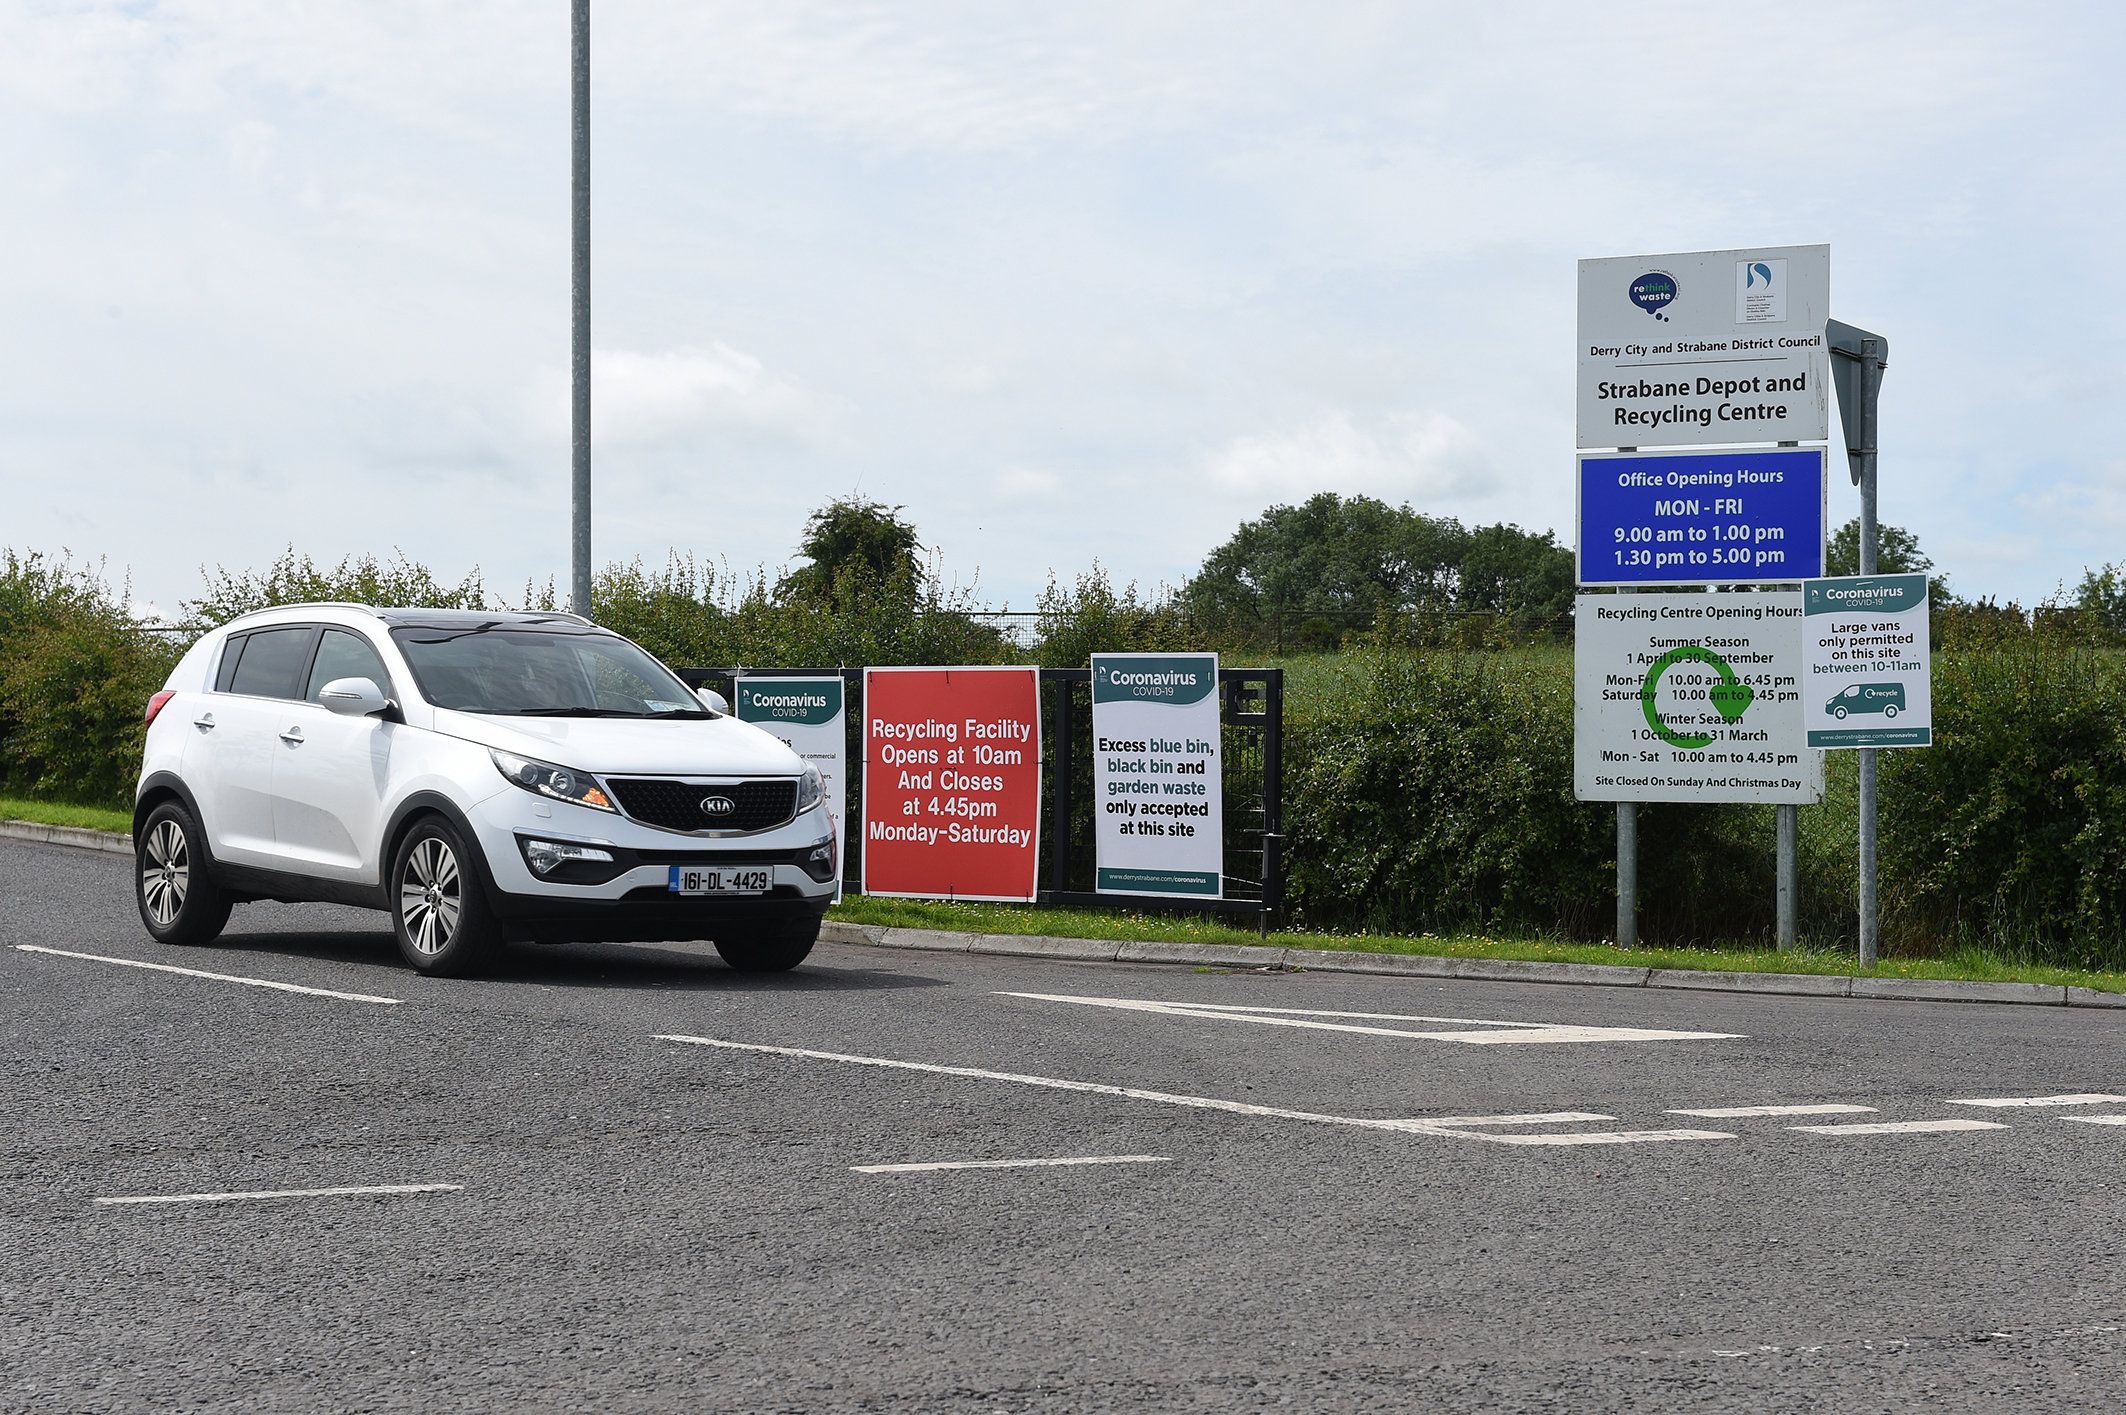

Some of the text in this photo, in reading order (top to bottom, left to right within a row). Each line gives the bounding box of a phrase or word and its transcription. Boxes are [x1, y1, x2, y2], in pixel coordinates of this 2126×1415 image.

[1634, 282, 1670, 292] rethink
[1640, 292, 1670, 301] waste
[1590, 336, 1820, 358] Derry City and Strabane District Council
[1598, 372, 1806, 399] Strabane Depot and
[1614, 404, 1787, 428] Recycling Centre
[1618, 470, 1784, 488] Office Opening Hours
[1654, 500, 1699, 516] MON
[1714, 498, 1742, 515] FRI
[1614, 524, 1784, 544] 9.00 am to 1.00 pm
[1614, 548, 1785, 568] 1.30 pm to 5.00 pm
[1826, 586, 1903, 600] Coronavirus
[1598, 607, 1657, 622] Recycling
[1660, 606, 1702, 618] Centre
[1706, 606, 1762, 620] Opening
[1832, 622, 1900, 634] Large vans
[1650, 636, 1749, 648] Summer Season
[1819, 633, 1914, 648] only permitted
[1627, 652, 1773, 666] 1 April to 30 September
[1832, 648, 1900, 660] on this site
[1813, 661, 1920, 674] between 10-11am
[1110, 670, 1196, 685] Coronavirus
[1606, 674, 1794, 688] Mon-Fri 10.00 am to 6.45 pm
[1133, 686, 1174, 696] COVID-19
[1602, 690, 1798, 703] Saturday 10.00 am to 4.45 pm
[753, 692, 826, 708] Coronavirus
[772, 708, 807, 718] COVID-19
[1655, 714, 1744, 724] Winter Season
[872, 719, 1030, 742] Recycling Facility
[1632, 730, 1768, 741] 1 October to 31 March
[1820, 732, 1918, 742] www.derrystrabane.com/coronavirus
[1099, 738, 1214, 756] Excess blue bin,
[882, 744, 1021, 767] Opens at 10am
[1602, 751, 1629, 762] Mon
[1640, 752, 1660, 762] Sat
[1672, 752, 1704, 762] 10.00
[1708, 754, 1727, 762] am
[1730, 754, 1743, 763] to
[1747, 752, 1774, 763] 4.45
[1777, 755, 1798, 766] pm
[1108, 758, 1204, 774] black bin and
[898, 770, 1003, 790] And Closes
[1108, 779, 1206, 796] garden waste
[1596, 776, 1801, 790] Site Closed On Sunday And Christmas Day
[707, 800, 730, 812] KIA
[903, 797, 996, 820] at 4.45pm
[1106, 800, 1208, 818] only accepted
[870, 821, 1031, 848] Monday-Saturday
[1120, 821, 1194, 836] at this site
[684, 872, 767, 890] 161-DL-4429
[1109, 874, 1206, 884] www.derrystrabane.com/coronavirus
